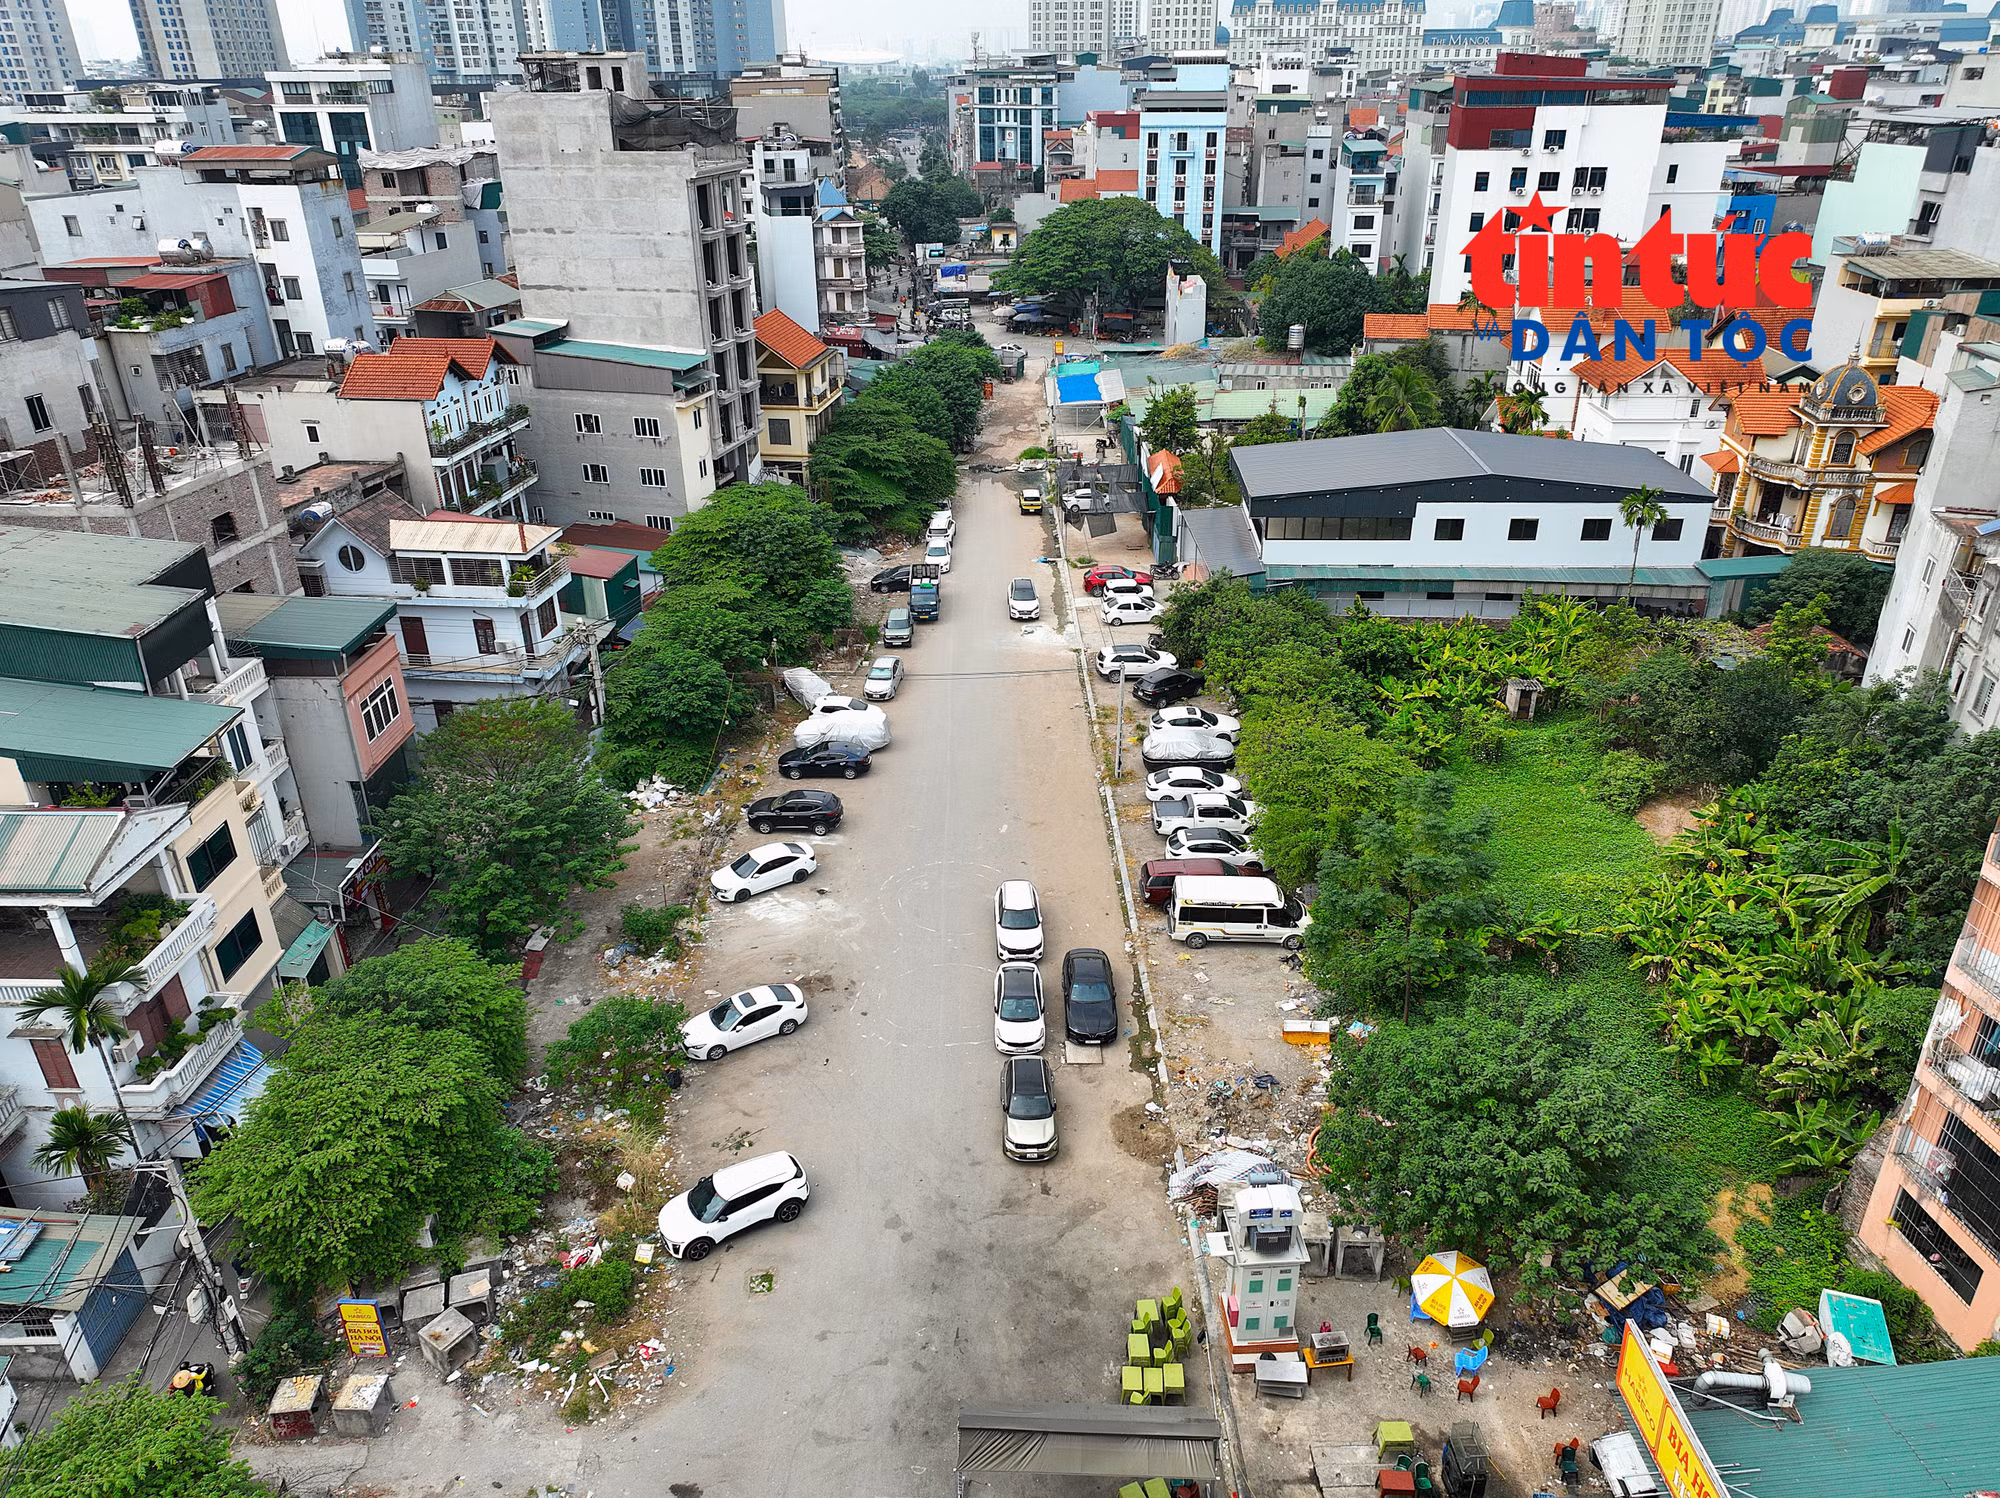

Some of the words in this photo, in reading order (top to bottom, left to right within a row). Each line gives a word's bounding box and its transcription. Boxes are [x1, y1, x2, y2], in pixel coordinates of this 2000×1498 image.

[1431, 37, 1446, 46] THE
[1448, 34, 1490, 46] MANOR
[1624, 1367, 1656, 1432] HABECO
[1667, 1422, 1689, 1477] BIA
